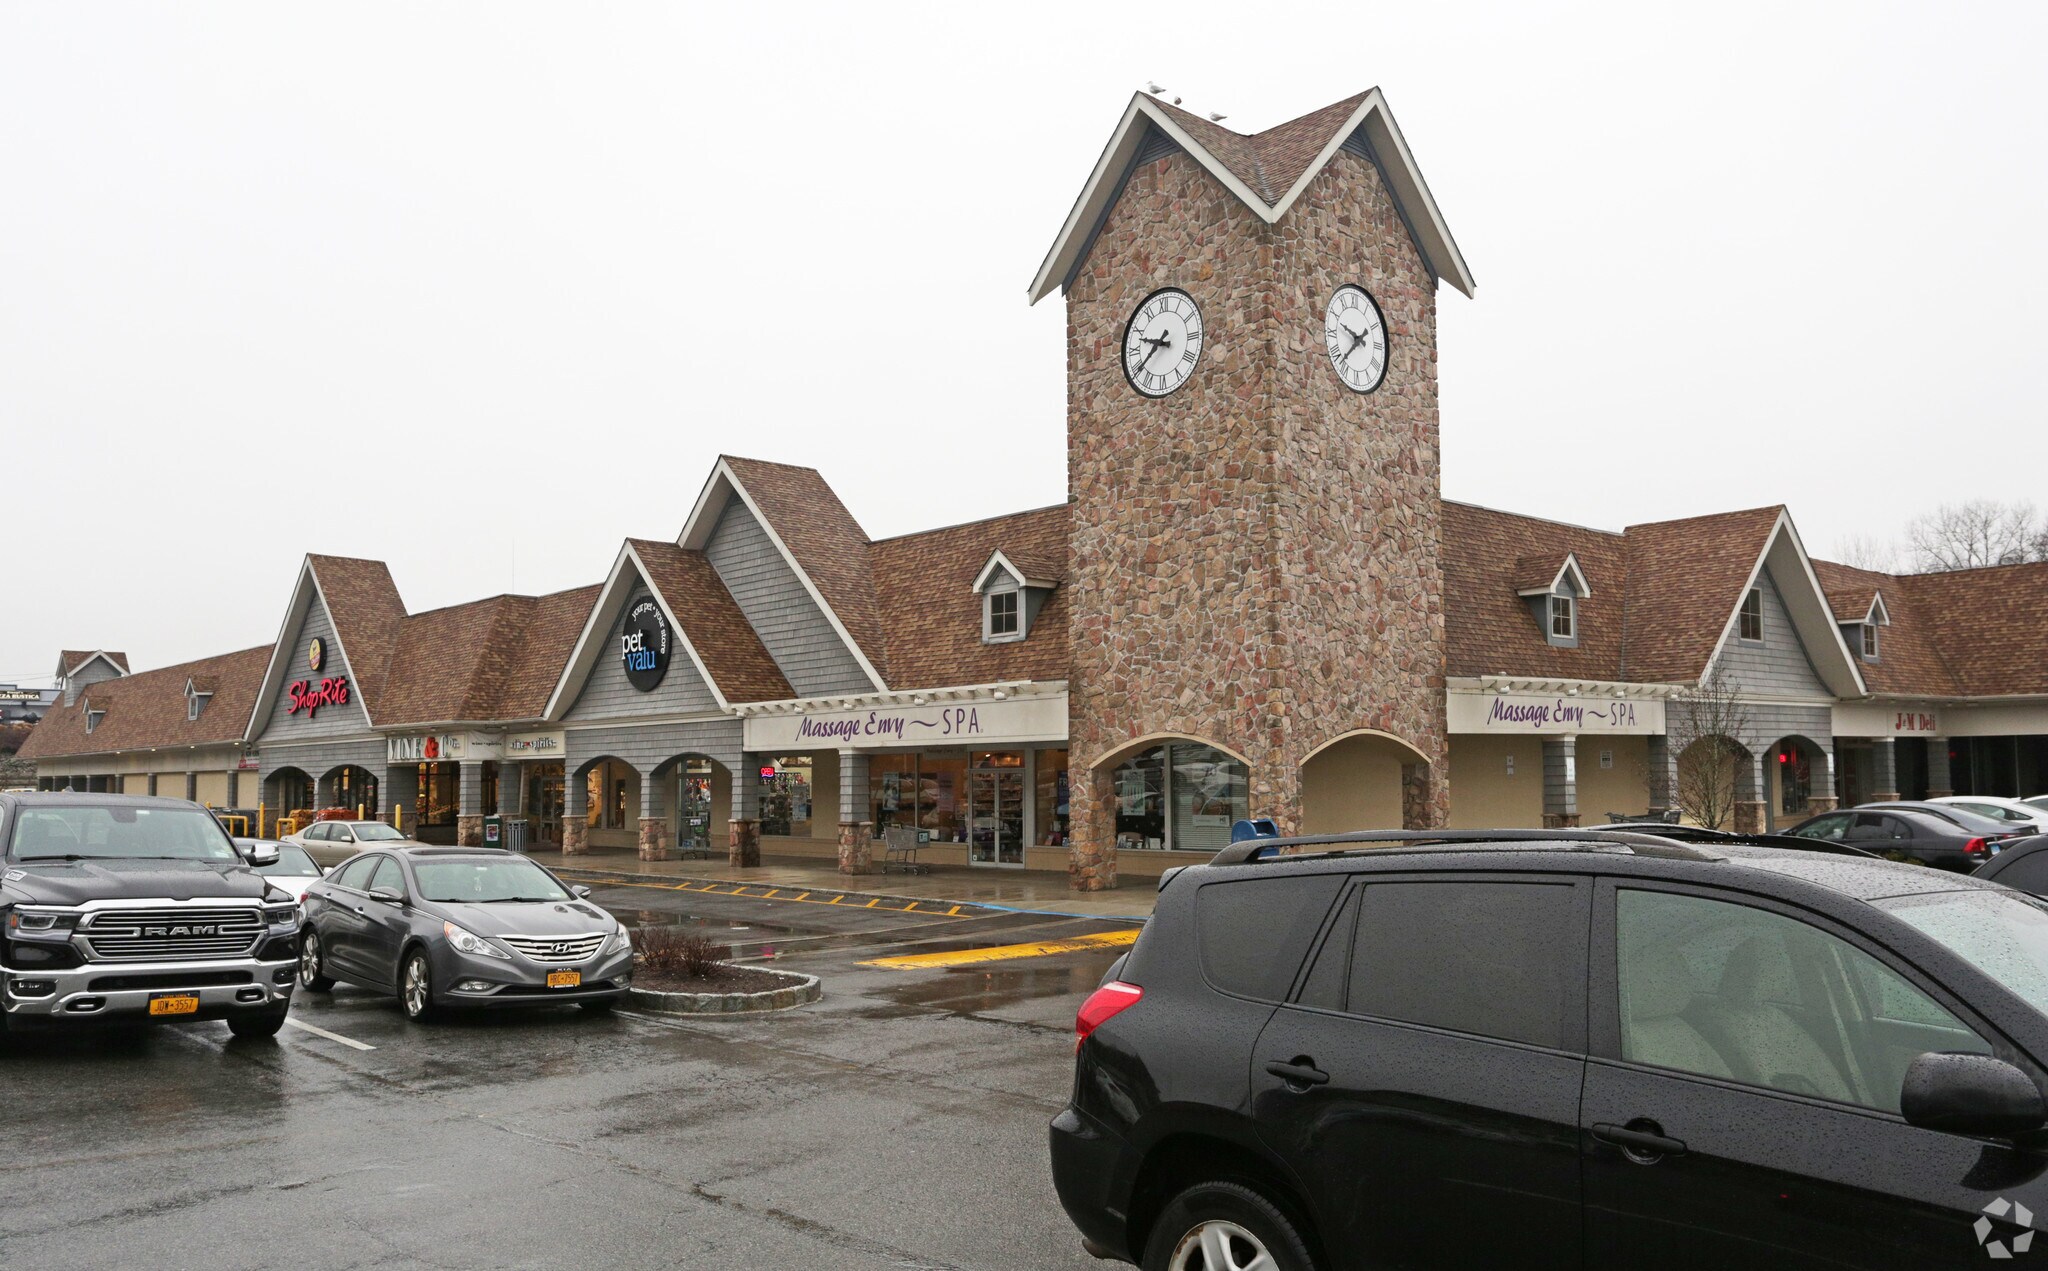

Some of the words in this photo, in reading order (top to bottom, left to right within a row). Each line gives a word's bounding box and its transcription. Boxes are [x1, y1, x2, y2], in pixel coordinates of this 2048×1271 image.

[632, 604, 643, 621] your
[643, 602, 653, 613] pet
[654, 608, 665, 629] your
[621, 629, 643, 659] pet
[627, 646, 655, 672] valu
[287, 677, 349, 719] ShopRite
[796, 716, 861, 742] Massage
[864, 711, 905, 740] Envy
[942, 707, 980, 735] SPA
[1487, 697, 1549, 728] Massage
[1553, 699, 1584, 728] Envy
[1610, 702, 1636, 726] SPA
[1918, 713, 1936, 731] Deli
[424, 735, 439, 759] &
[144, 925, 215, 936] RAM
